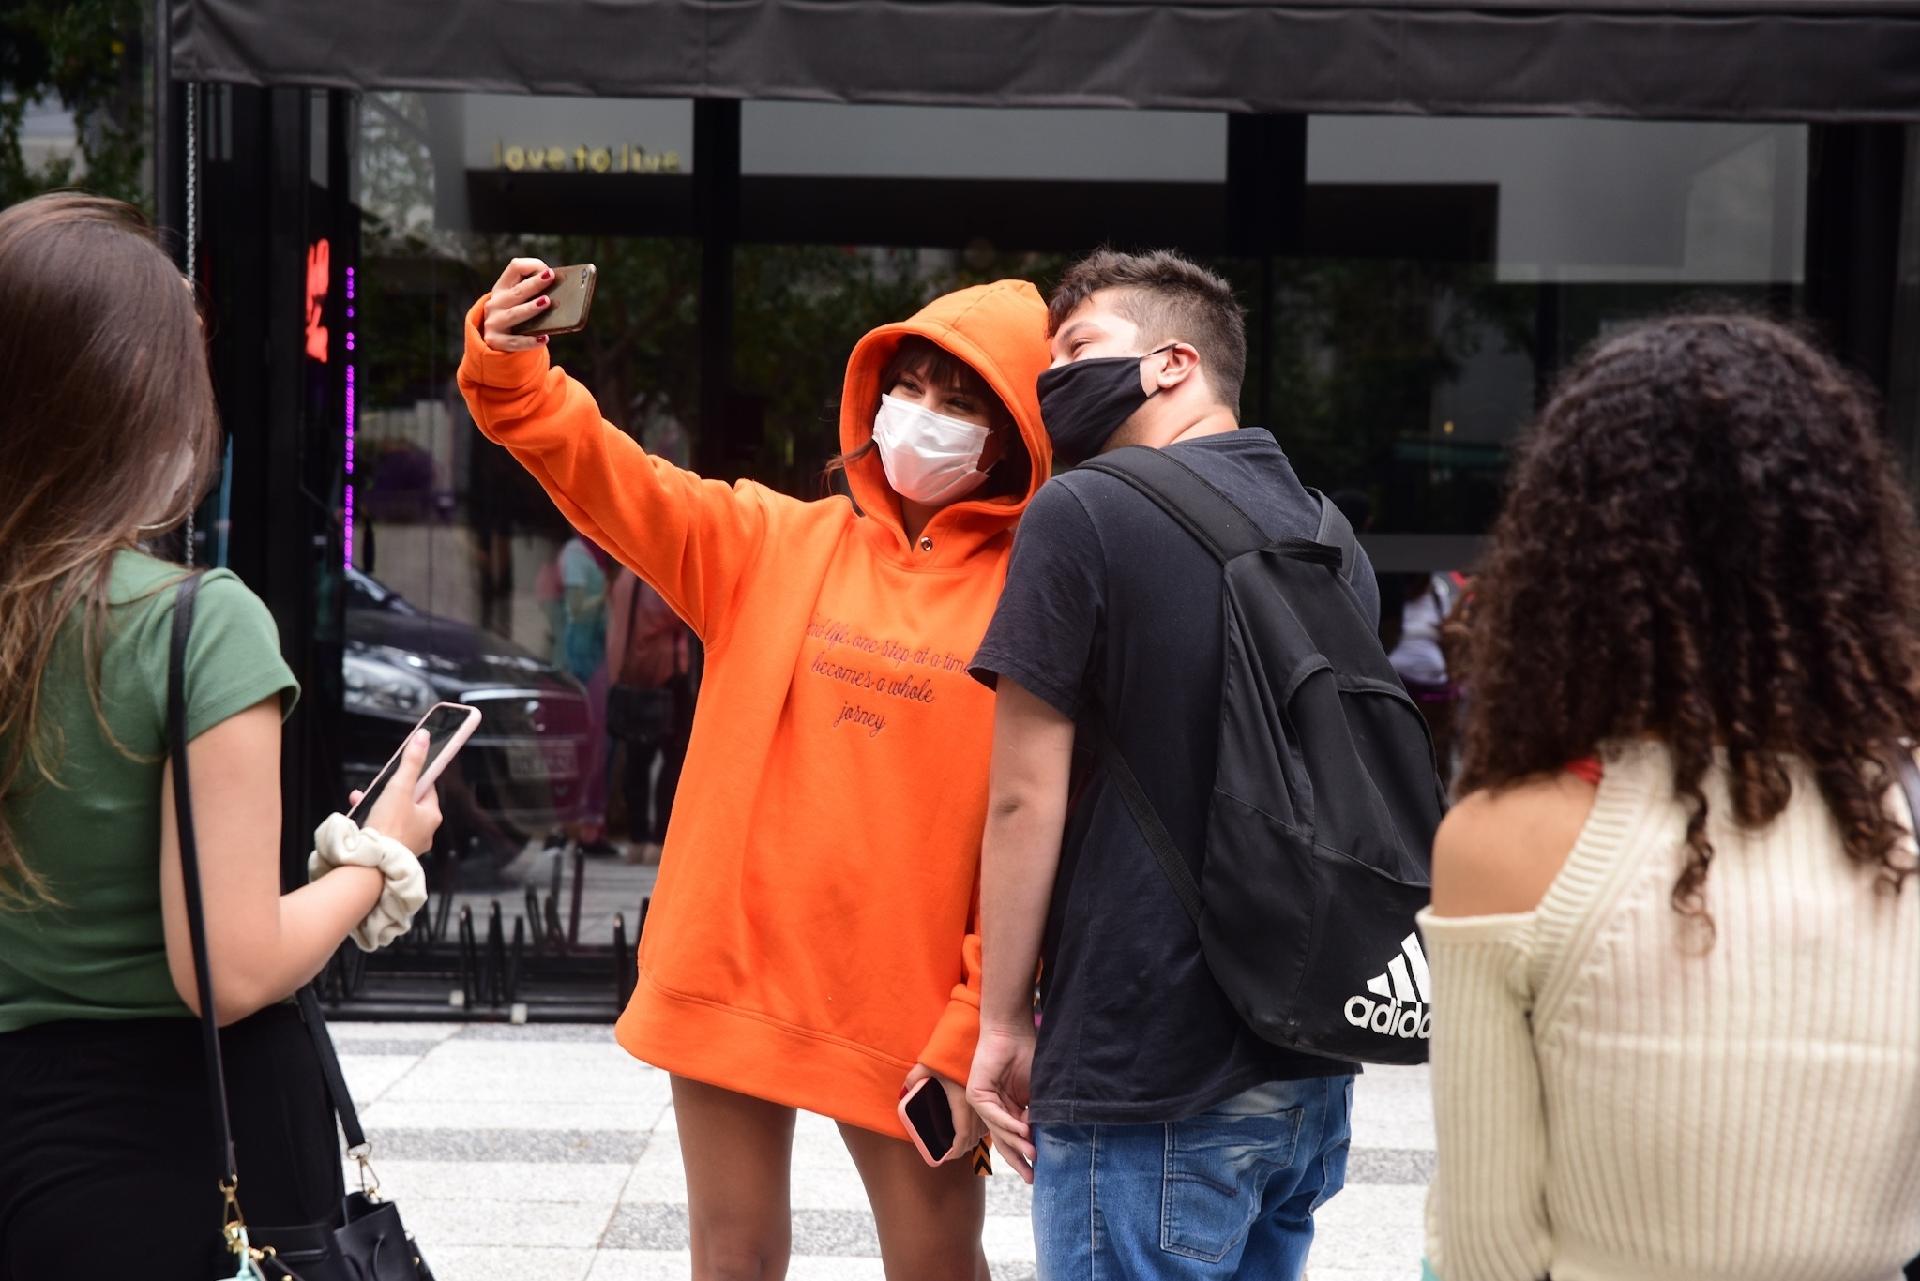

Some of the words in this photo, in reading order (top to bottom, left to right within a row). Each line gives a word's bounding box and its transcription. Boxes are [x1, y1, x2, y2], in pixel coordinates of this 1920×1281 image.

[574, 144, 612, 173] to
[852, 635, 880, 653] one
[881, 640, 911, 669] step
[914, 646, 931, 664] at
[930, 654, 941, 667] a
[811, 651, 875, 688] becomes
[876, 677, 887, 691] a
[887, 674, 934, 703] whole
